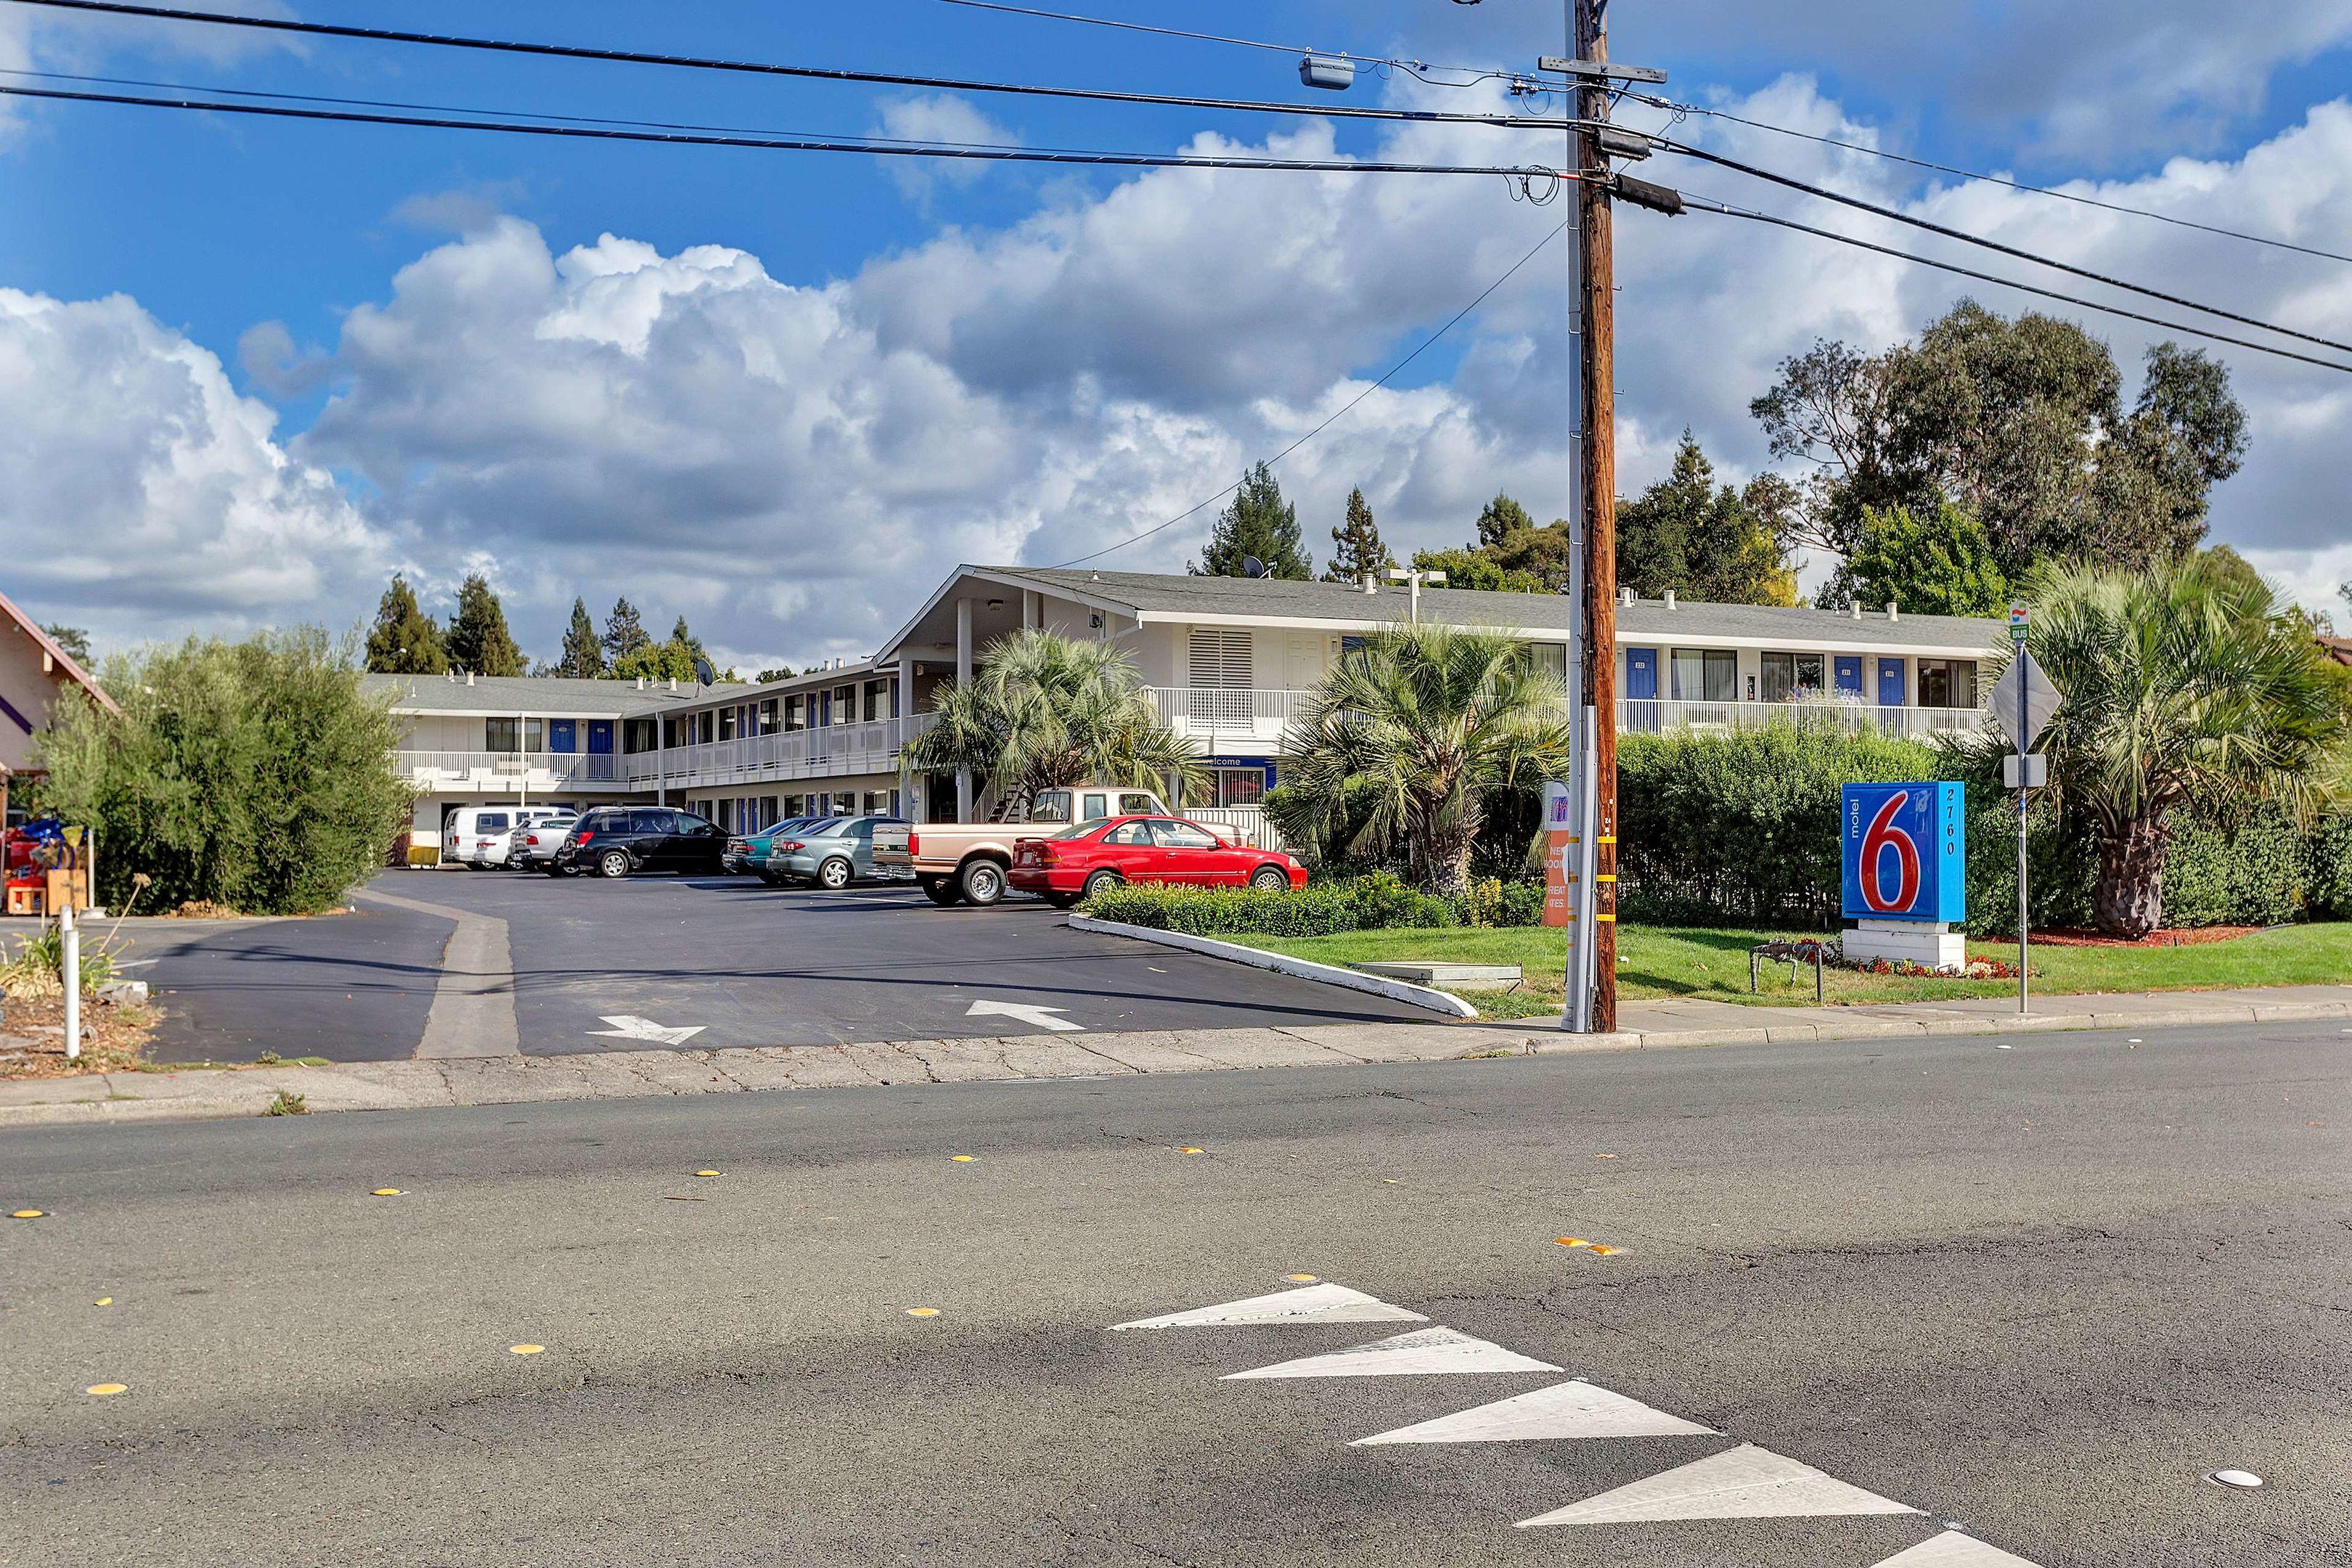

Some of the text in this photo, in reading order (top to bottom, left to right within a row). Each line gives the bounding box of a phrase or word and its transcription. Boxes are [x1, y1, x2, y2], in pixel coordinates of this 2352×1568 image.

[2012, 630, 2028, 639] BUS
[1946, 788, 1955, 855] 2760
[1550, 846, 1563, 855] NE
[1859, 790, 1921, 912] 6
